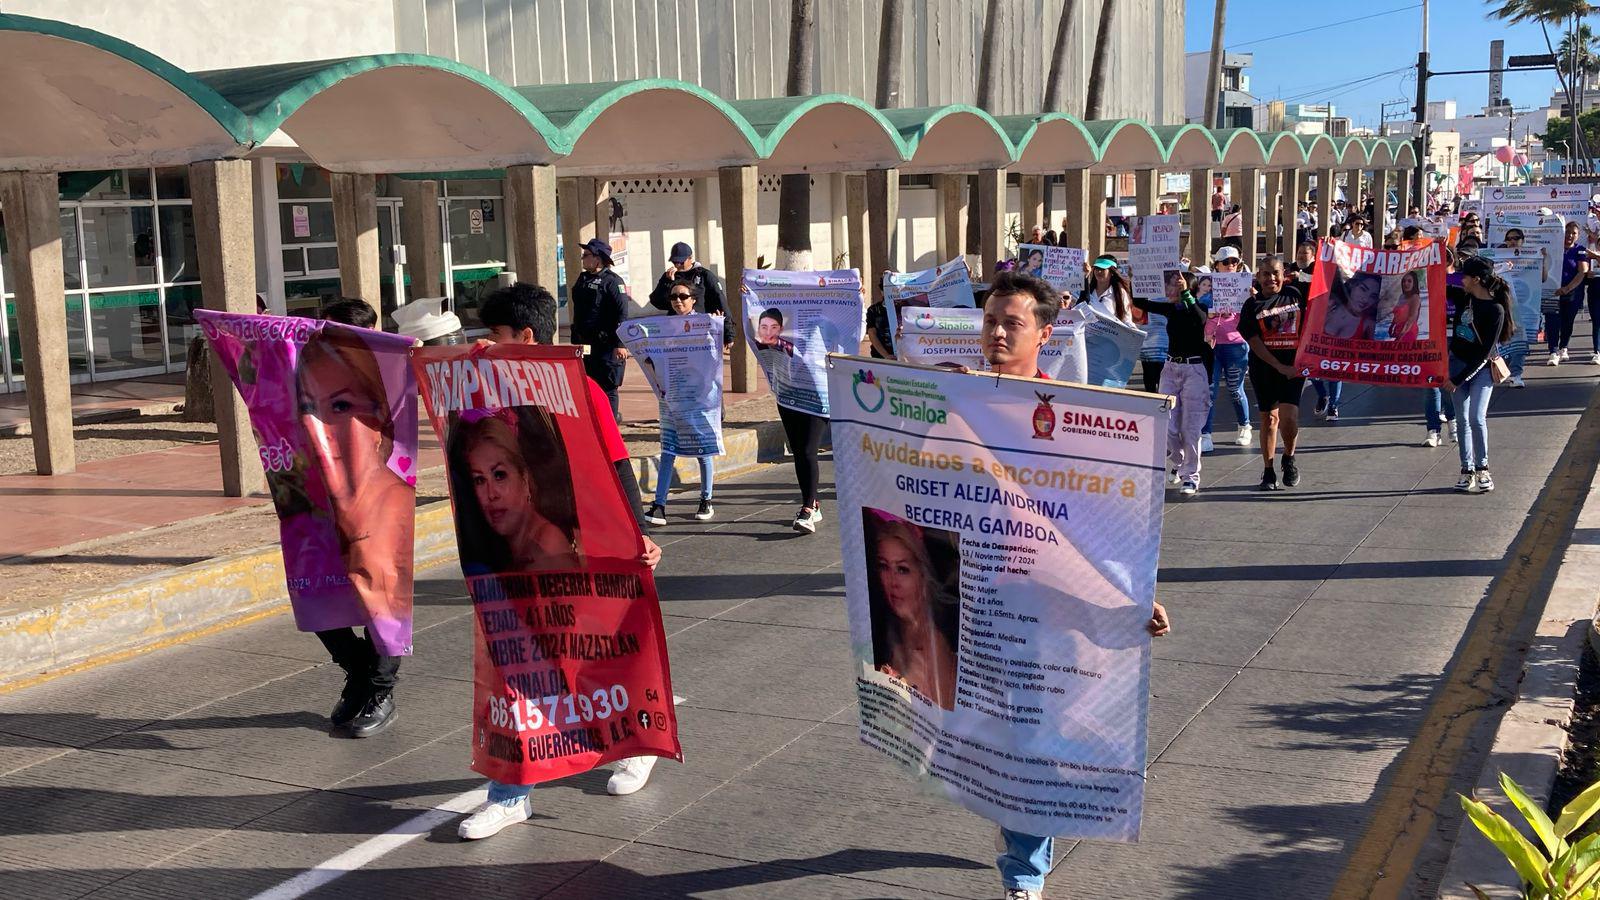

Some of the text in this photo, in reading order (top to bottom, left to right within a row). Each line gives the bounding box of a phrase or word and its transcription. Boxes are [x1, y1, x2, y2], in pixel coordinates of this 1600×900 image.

[918, 336, 982, 346] Ayúdanos
[1320, 360, 1421, 375] 667 157 1930
[425, 359, 579, 418] DESAPARECIDA
[890, 396, 947, 424] Sinaloa
[1063, 411, 1139, 433] SINALOA
[1062, 426, 1139, 441] GOBIERNO DEL ESTADO
[861, 432, 1136, 498] Ayúdanos a encontrar a
[896, 474, 1069, 521] GRISET ALEJANDRINA
[905, 504, 1059, 545] BECERRA GAMBOA
[962, 538, 980, 547] Fecha
[982, 541, 990, 549] de
[963, 559, 1031, 576] Municipio del hecho:
[975, 552, 1011, 562] Noviembre
[1013, 556, 1017, 564] /
[1019, 556, 1035, 565] 2024
[594, 573, 644, 599] GAMBOA
[977, 586, 998, 595] Mujer
[977, 597, 985, 605] 41
[987, 598, 1003, 606] años
[525, 607, 541, 628] 41
[544, 601, 576, 627] AÑOS
[971, 618, 993, 627] Blanca
[531, 633, 567, 661] 2024
[974, 640, 1002, 651] Redonda
[998, 633, 1026, 644] Mediana
[973, 651, 1003, 664] Medianos
[1043, 664, 1061, 672] color
[1079, 669, 1102, 679] oscuro
[975, 661, 1002, 674] Mediana
[1007, 670, 1045, 681] respingada
[506, 668, 569, 701] SINALOA
[959, 666, 982, 679] Cabello:
[1023, 683, 1045, 692] teñido
[1047, 686, 1065, 694] rubio
[959, 676, 979, 688] Frente:
[645, 687, 659, 702] 64
[958, 686, 975, 697] Boca:
[1016, 705, 1043, 714] gruesos
[489, 684, 629, 732] 661571930
[957, 698, 974, 709] Cejas:
[974, 703, 1000, 718] Tatuadas
[1005, 714, 1041, 725] arqueadas
[942, 730, 959, 742] Cicatriz
[993, 750, 1004, 758] uno
[1005, 752, 1013, 761] de
[1014, 755, 1024, 763] sus
[1025, 757, 1049, 767] tobillos
[1094, 785, 1119, 793] leyenda
